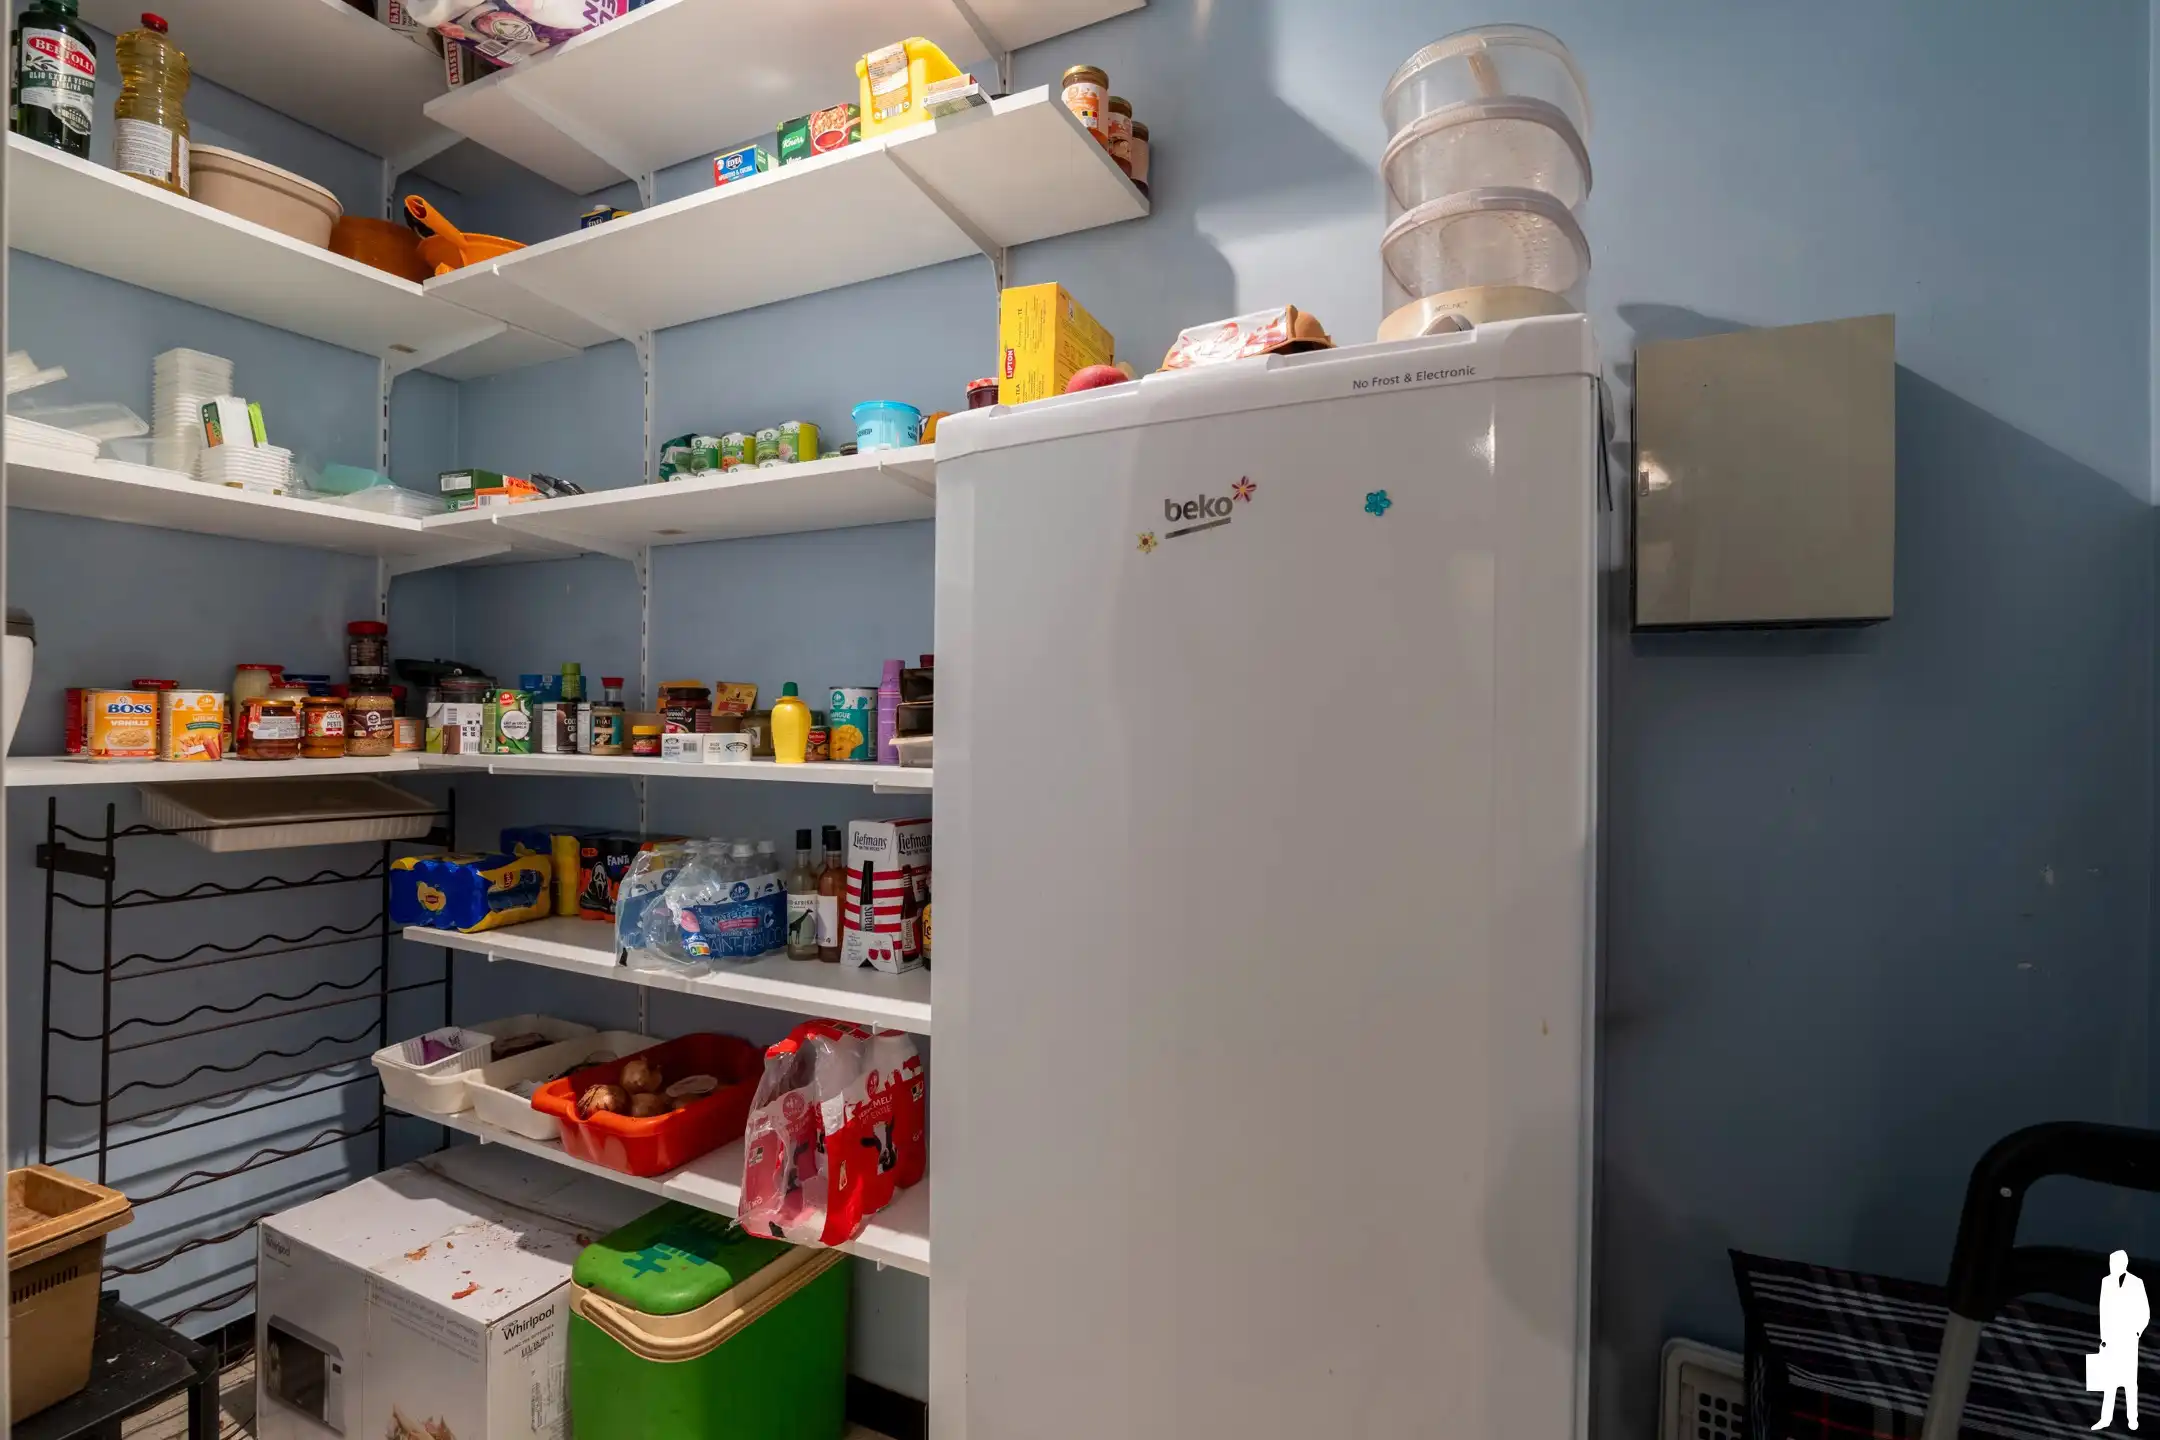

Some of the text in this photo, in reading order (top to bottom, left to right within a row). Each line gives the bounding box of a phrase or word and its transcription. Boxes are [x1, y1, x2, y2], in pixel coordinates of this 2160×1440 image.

[1006, 349, 1015, 379] LIPTON
[1353, 365, 1476, 390] No Frost & Electronic
[1164, 494, 1233, 522] beko
[107, 703, 152, 714] BOSS
[852, 831, 888, 851] Liefmans
[504, 1304, 555, 1340] Whirlpool
